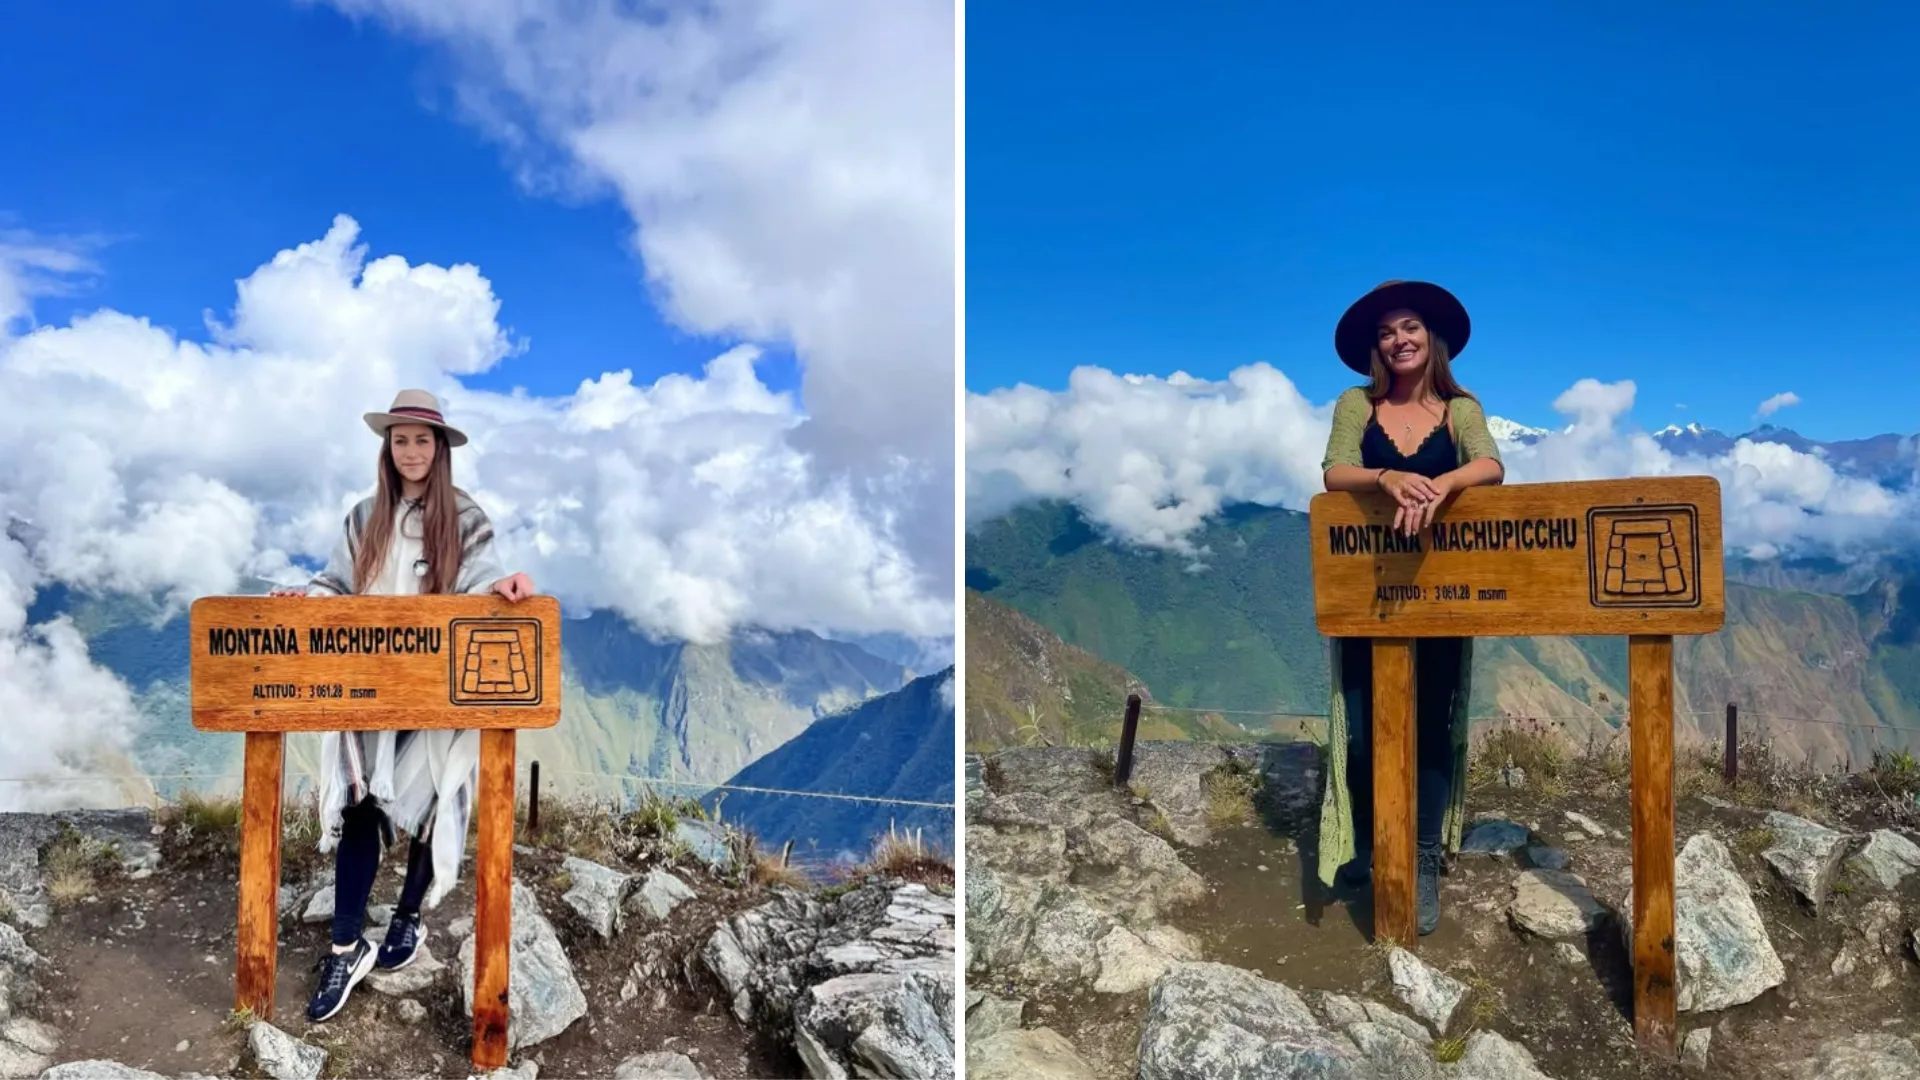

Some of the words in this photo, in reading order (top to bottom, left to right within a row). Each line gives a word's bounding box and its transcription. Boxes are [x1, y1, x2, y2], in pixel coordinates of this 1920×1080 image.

[1433, 518, 1577, 552] MACHUPICCHU
[1478, 589, 1507, 600] msnm
[209, 624, 299, 656] MONTAÑA
[309, 627, 441, 655] MACHUPICCHU
[350, 688, 377, 698] msnm
